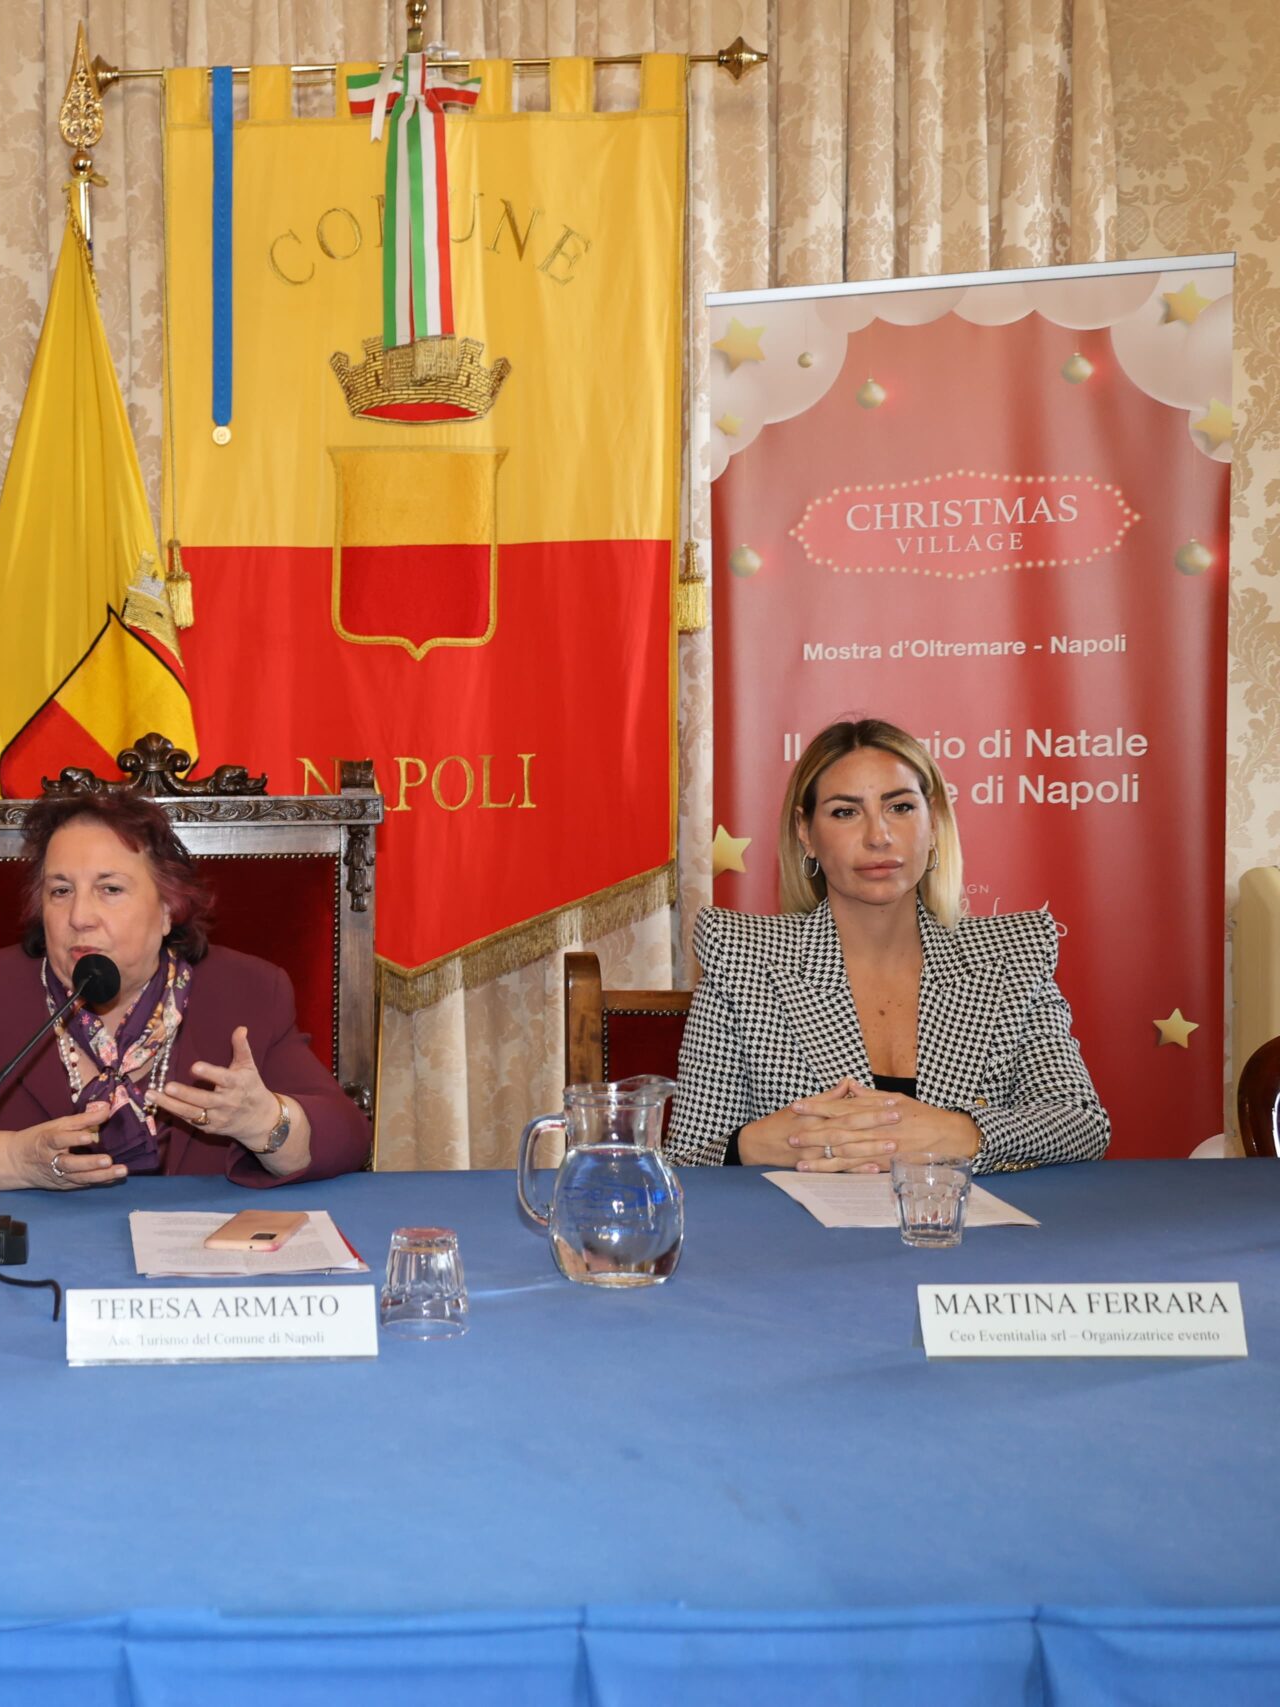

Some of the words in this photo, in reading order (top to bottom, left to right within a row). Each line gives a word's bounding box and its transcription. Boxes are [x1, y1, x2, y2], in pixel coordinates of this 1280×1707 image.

[270, 194, 592, 286] COUNE
[846, 495, 1079, 531] CHRISTMAS
[896, 533, 1024, 554] VILLAGE
[803, 642, 882, 661] Mostra
[1050, 634, 1127, 657] Napoli
[784, 733, 801, 762] Il
[979, 729, 1012, 759] di
[1026, 727, 1149, 758] Natale
[296, 753, 537, 811] NPOLI
[971, 775, 1004, 804] di
[1019, 774, 1140, 810] Napoli
[91, 1297, 202, 1320] TERESA
[212, 1294, 340, 1319] ARMATO
[934, 1292, 1078, 1315] MARTINA
[1087, 1291, 1230, 1314] FERRARA
[138, 1334, 189, 1347] Turismo
[192, 1333, 210, 1346] del
[214, 1333, 265, 1346] Comune
[268, 1332, 281, 1345] di
[284, 1331, 325, 1347] Napoli
[949, 1330, 975, 1343] Ceo
[979, 1329, 1047, 1343] Eventitalia
[1050, 1329, 1066, 1342] srl
[1081, 1329, 1174, 1345] Organizzatrice
[1178, 1331, 1220, 1342] evento
